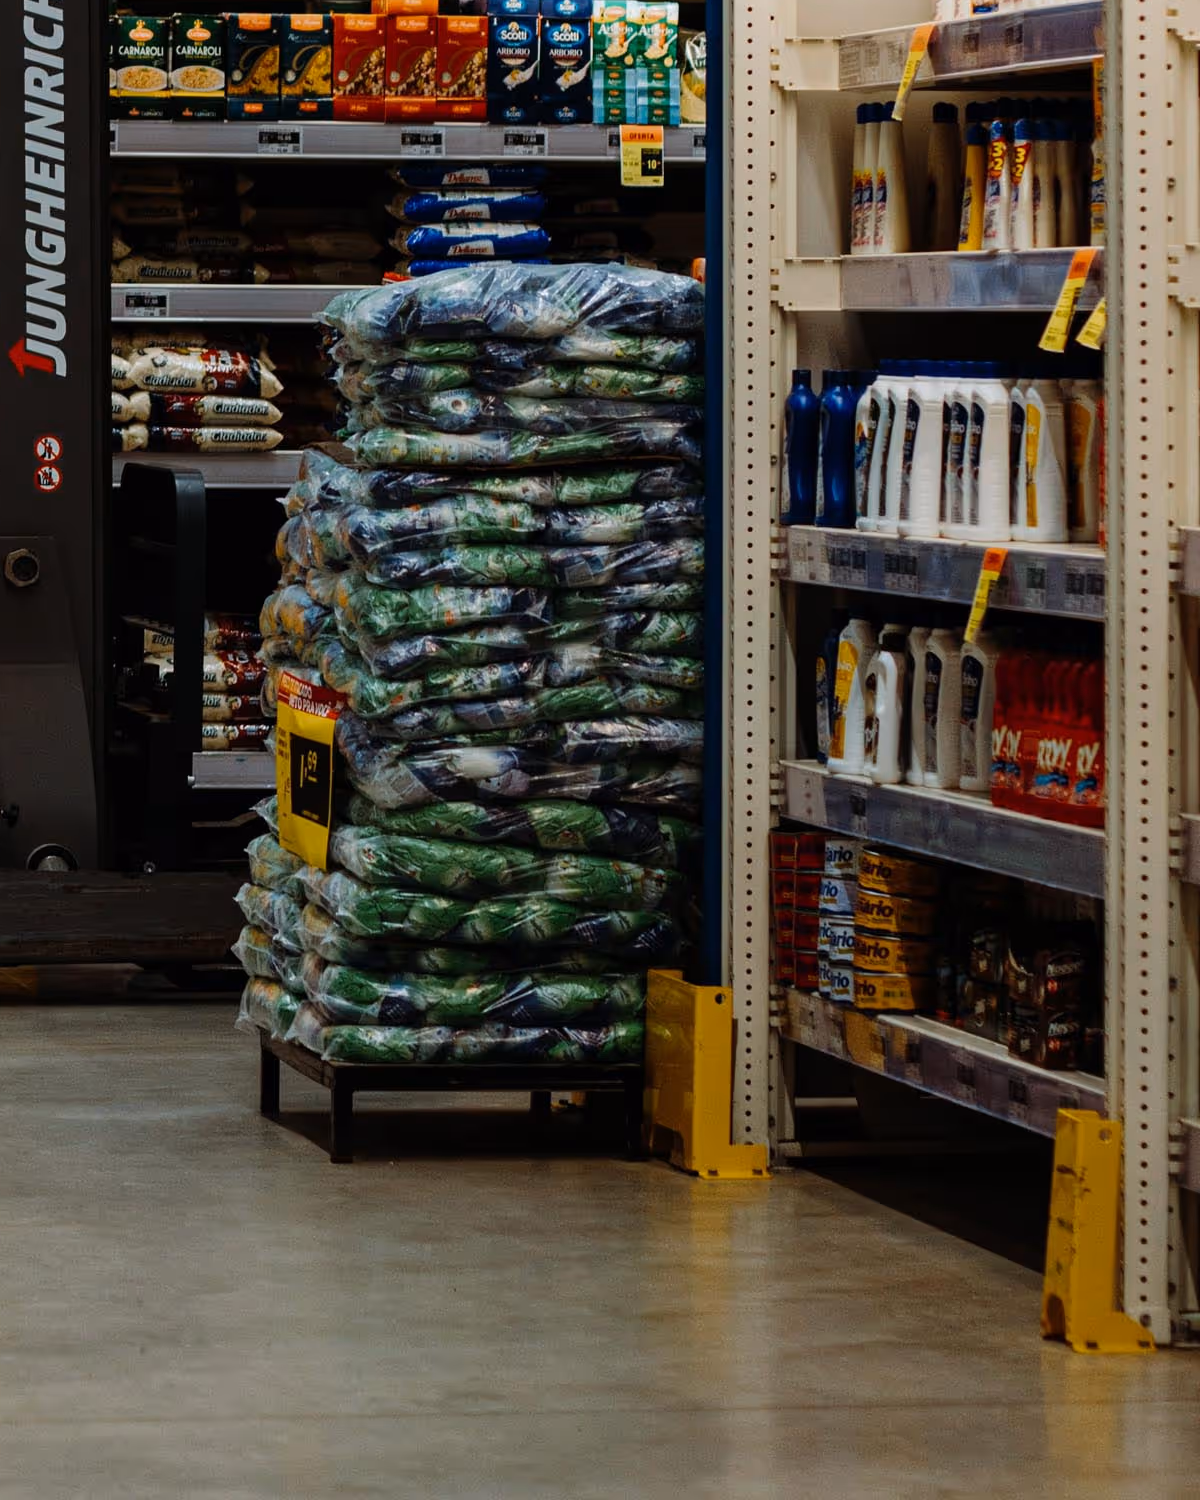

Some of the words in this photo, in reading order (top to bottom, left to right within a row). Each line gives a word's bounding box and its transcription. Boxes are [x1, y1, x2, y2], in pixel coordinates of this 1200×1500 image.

[500, 29, 527, 40] Scotti
[553, 30, 579, 42] Scotti
[118, 45, 164, 56] CARNAROLI
[175, 45, 221, 56] CARNAROLI
[629, 132, 655, 140] OFERTA
[992, 141, 1003, 157] 3
[1015, 148, 1026, 163] 3
[646, 159, 657, 170] 10
[993, 158, 1004, 171] 2
[1015, 164, 1024, 177] 2
[143, 375, 196, 388] Gladiador
[213, 402, 269, 415] Gladiador
[211, 430, 267, 442] Gladiador
